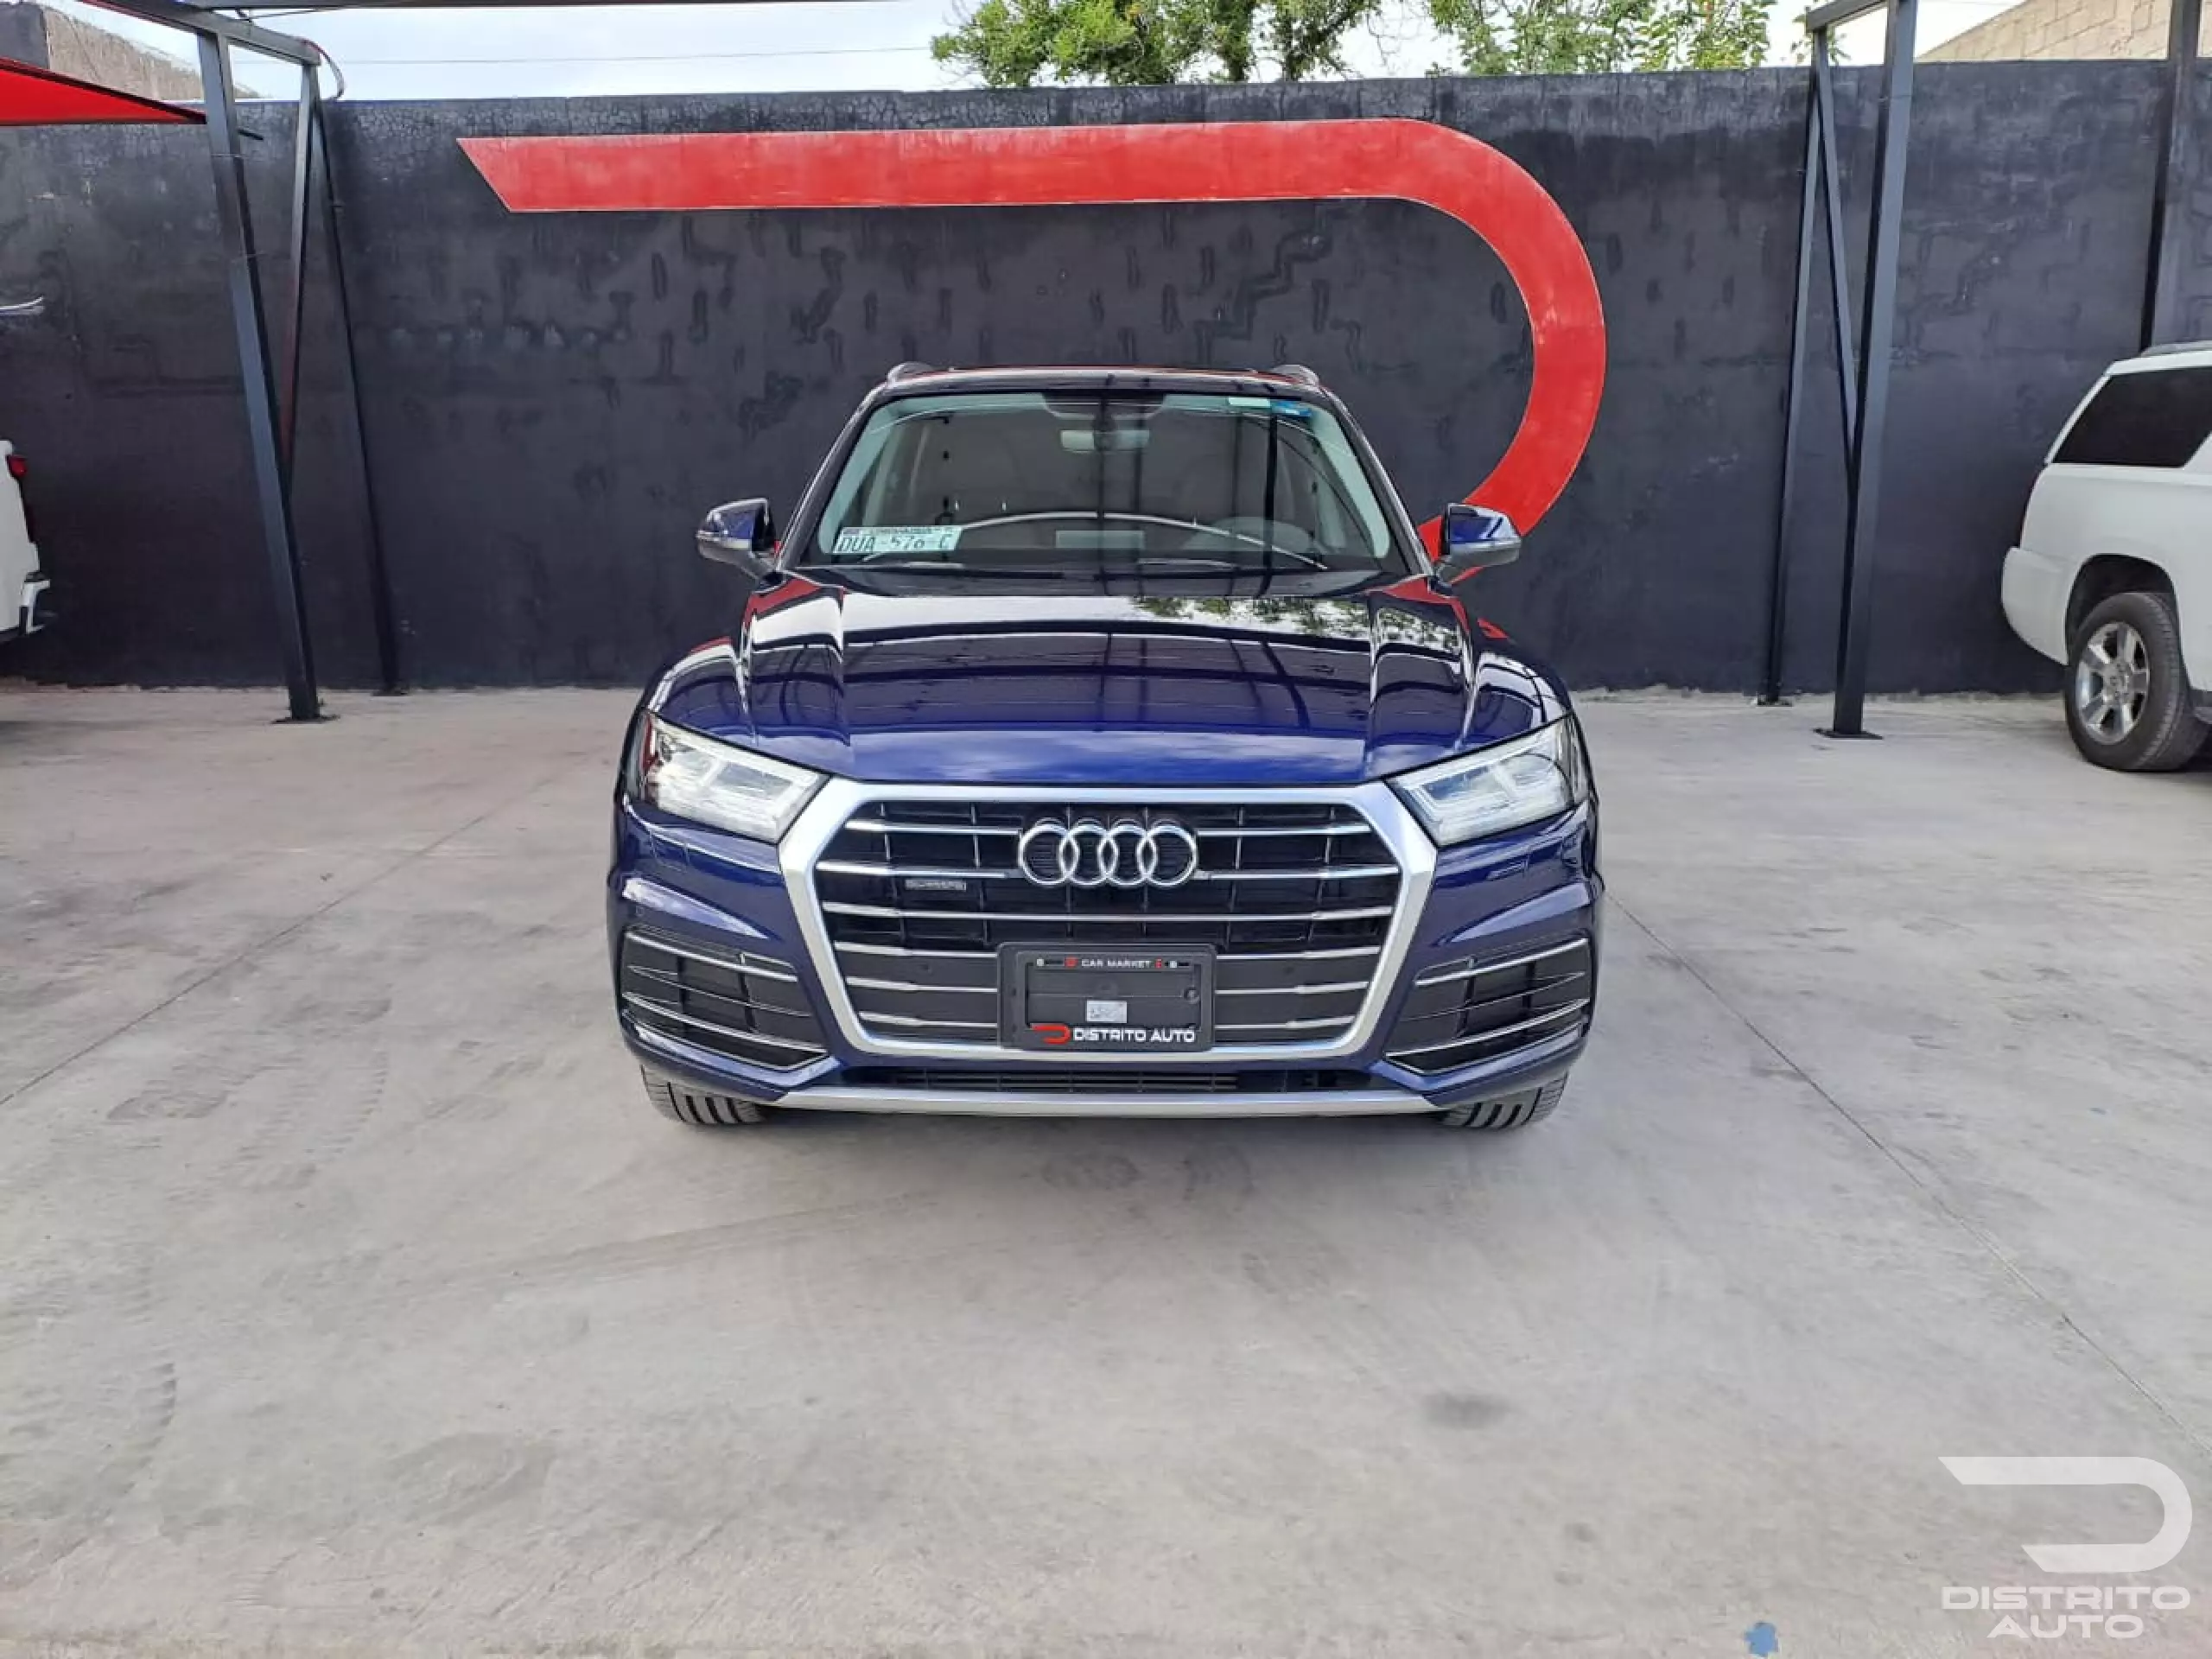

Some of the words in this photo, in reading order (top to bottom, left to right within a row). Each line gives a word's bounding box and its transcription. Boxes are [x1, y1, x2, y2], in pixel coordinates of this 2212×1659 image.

[1081, 958, 1103, 968] CAR
[1107, 959, 1151, 969] MARKET
[1073, 1028, 1147, 1042] DISTRITO
[1150, 1028, 1196, 1043] AUTO
